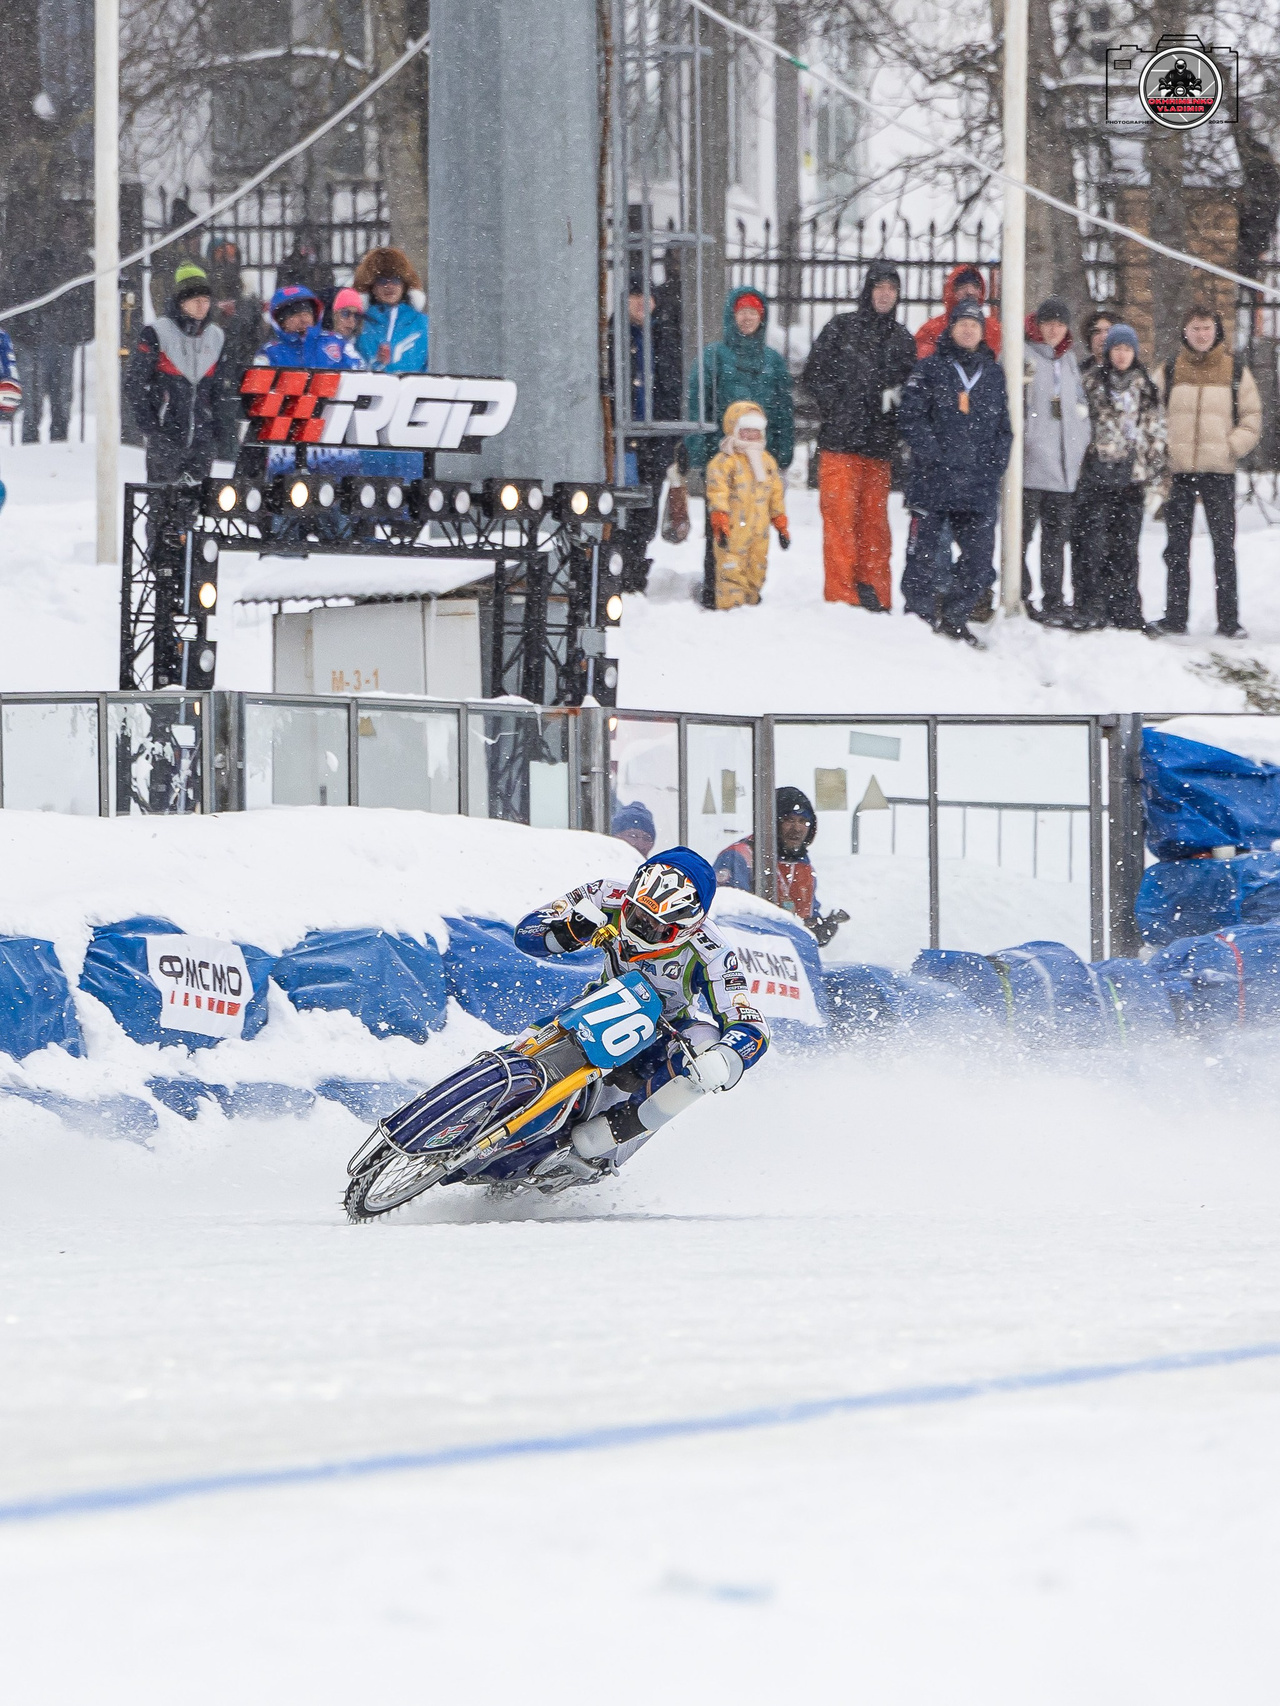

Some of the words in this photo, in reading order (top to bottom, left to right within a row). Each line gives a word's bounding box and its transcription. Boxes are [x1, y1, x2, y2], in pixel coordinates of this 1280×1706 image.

[320, 372, 518, 449] RGP
[641, 896, 658, 910] SHOEI
[159, 955, 242, 997] ФМСМО
[570, 977, 655, 1057] 176
